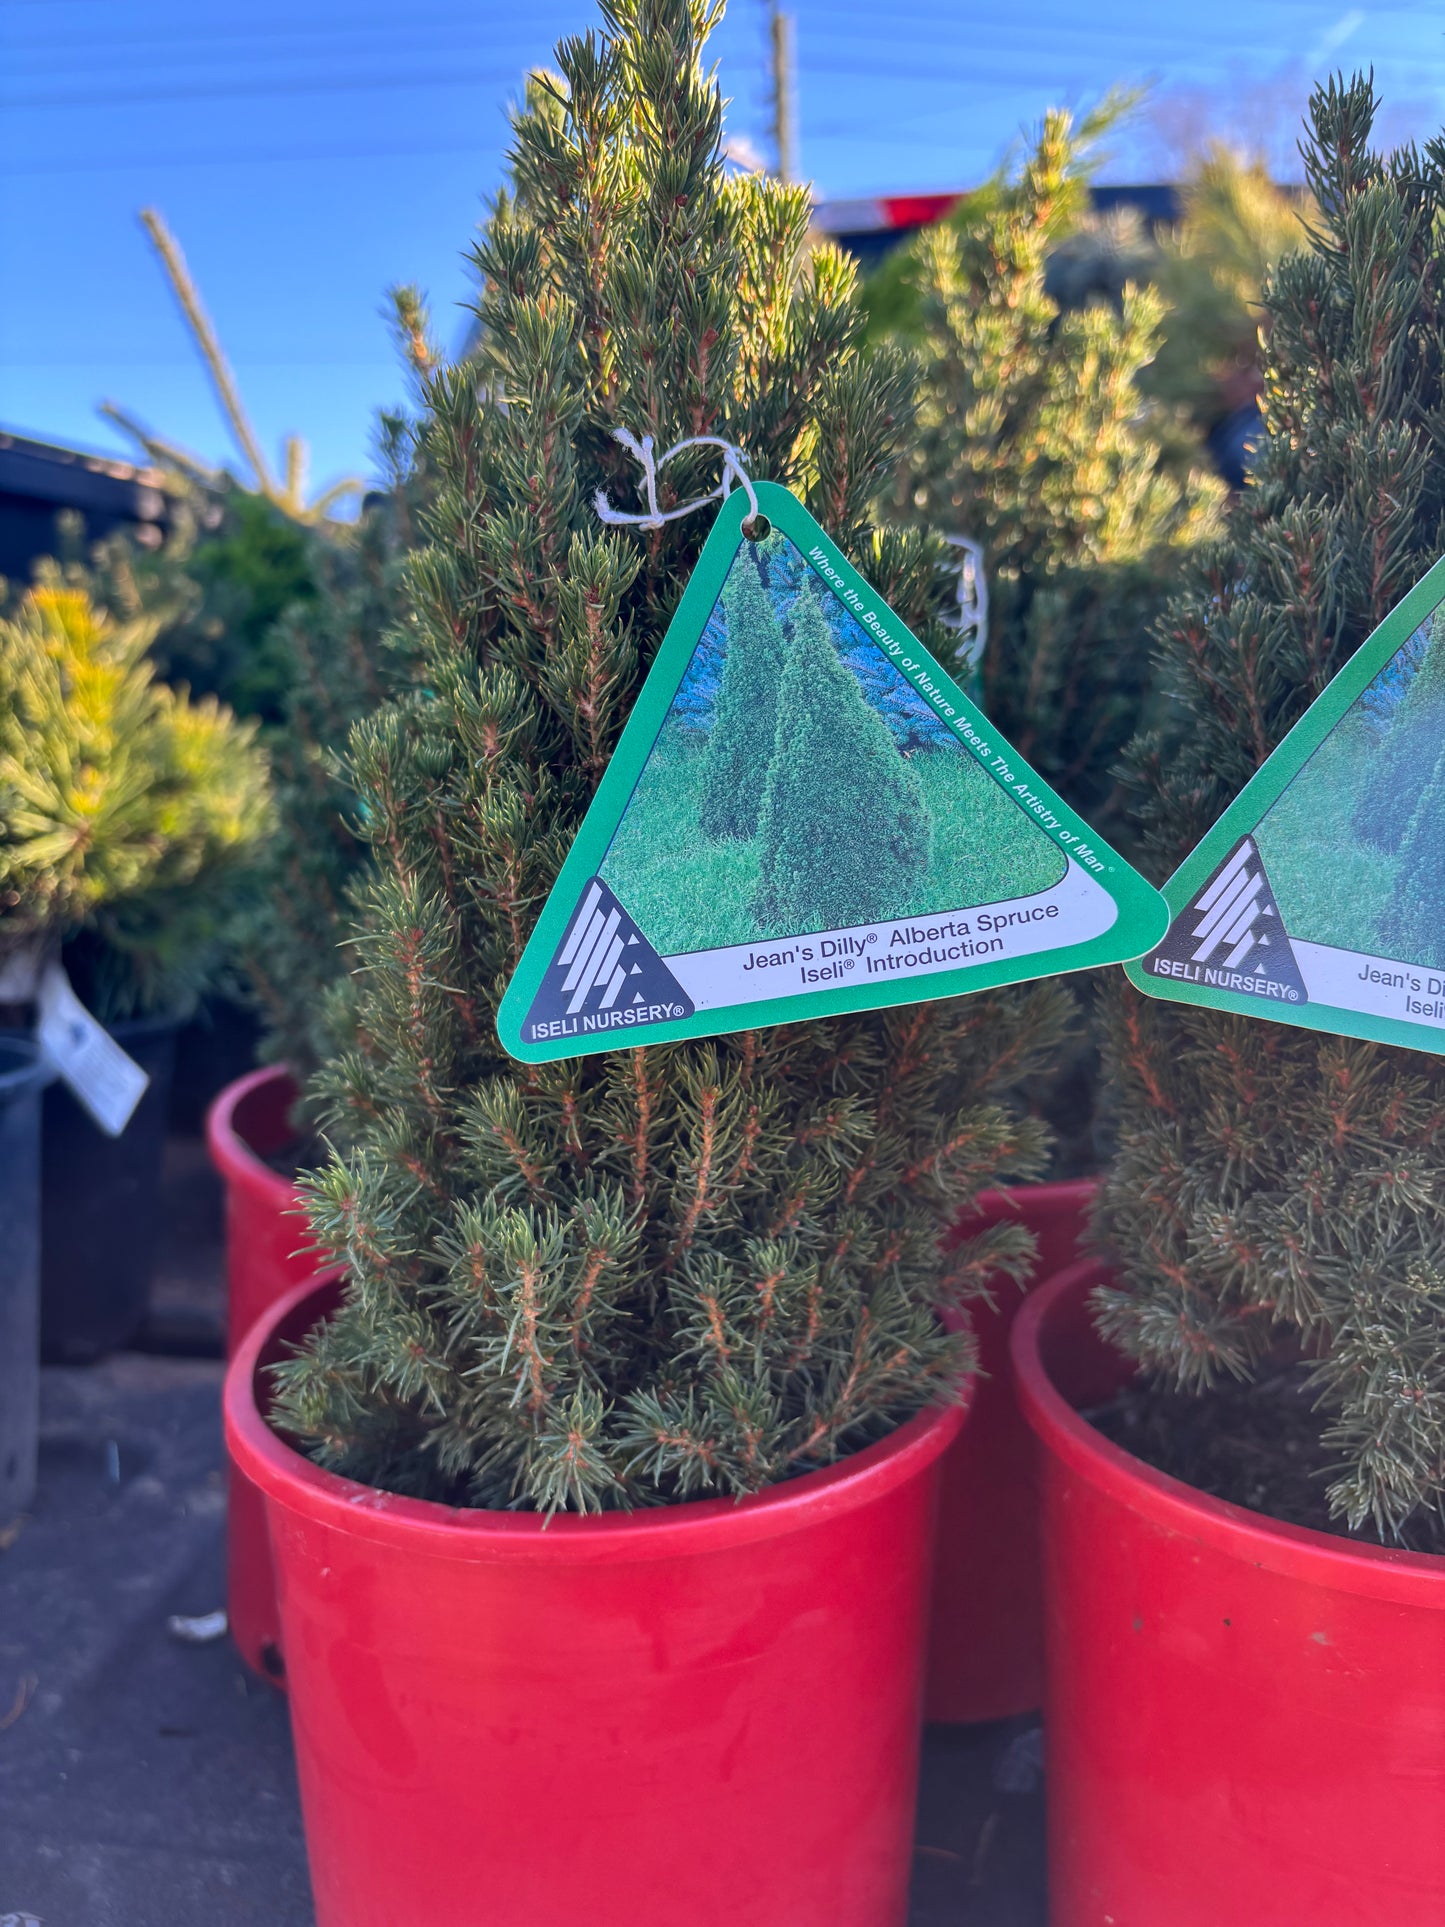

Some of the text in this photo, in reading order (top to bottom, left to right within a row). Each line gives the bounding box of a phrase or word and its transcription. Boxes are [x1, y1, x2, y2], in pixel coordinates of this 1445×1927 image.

[808, 546, 845, 588] Where
[843, 589, 864, 611] the
[862, 611, 903, 656] Beauty
[901, 658, 920, 671] of
[914, 672, 955, 716] Nature
[953, 716, 992, 757] Meets
[991, 756, 1015, 782] The
[1012, 784, 1061, 829] Artistry
[1059, 830, 1080, 844] of
[742, 946, 814, 971] Jean's
[889, 921, 971, 947] Alberta
[977, 904, 1060, 933] Spruce
[866, 937, 1004, 973] Introduction
[1153, 957, 1199, 981] ISELI
[1358, 964, 1421, 992] Jean's
[1406, 995, 1445, 1019] Iseli
[531, 1017, 578, 1040] ISELI
